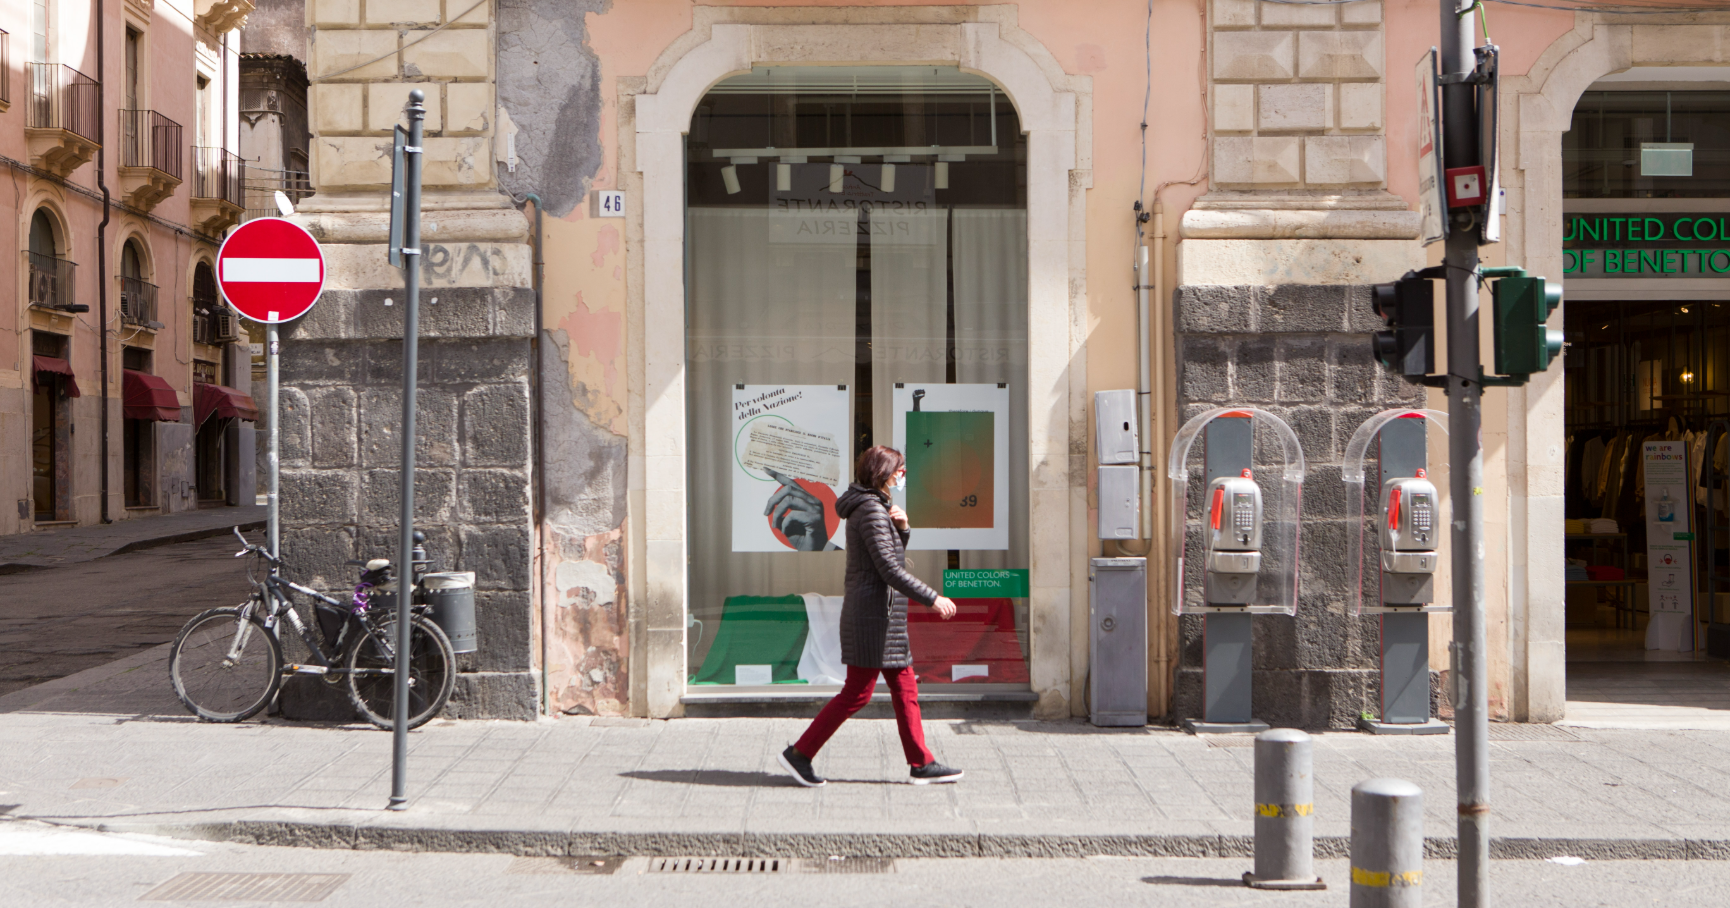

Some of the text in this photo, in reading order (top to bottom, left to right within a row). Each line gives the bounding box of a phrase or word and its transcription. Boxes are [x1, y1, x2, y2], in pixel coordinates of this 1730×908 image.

[603, 195, 621, 212] 46
[1563, 217, 1730, 241] UNITED COL
[1563, 249, 1730, 273] OF BENETTO
[735, 401, 752, 410] Per
[738, 391, 802, 420] della Nazione!
[1645, 452, 1683, 460] rainbows
[945, 571, 1010, 579] UNITED COLORS
[945, 580, 956, 588] OF
